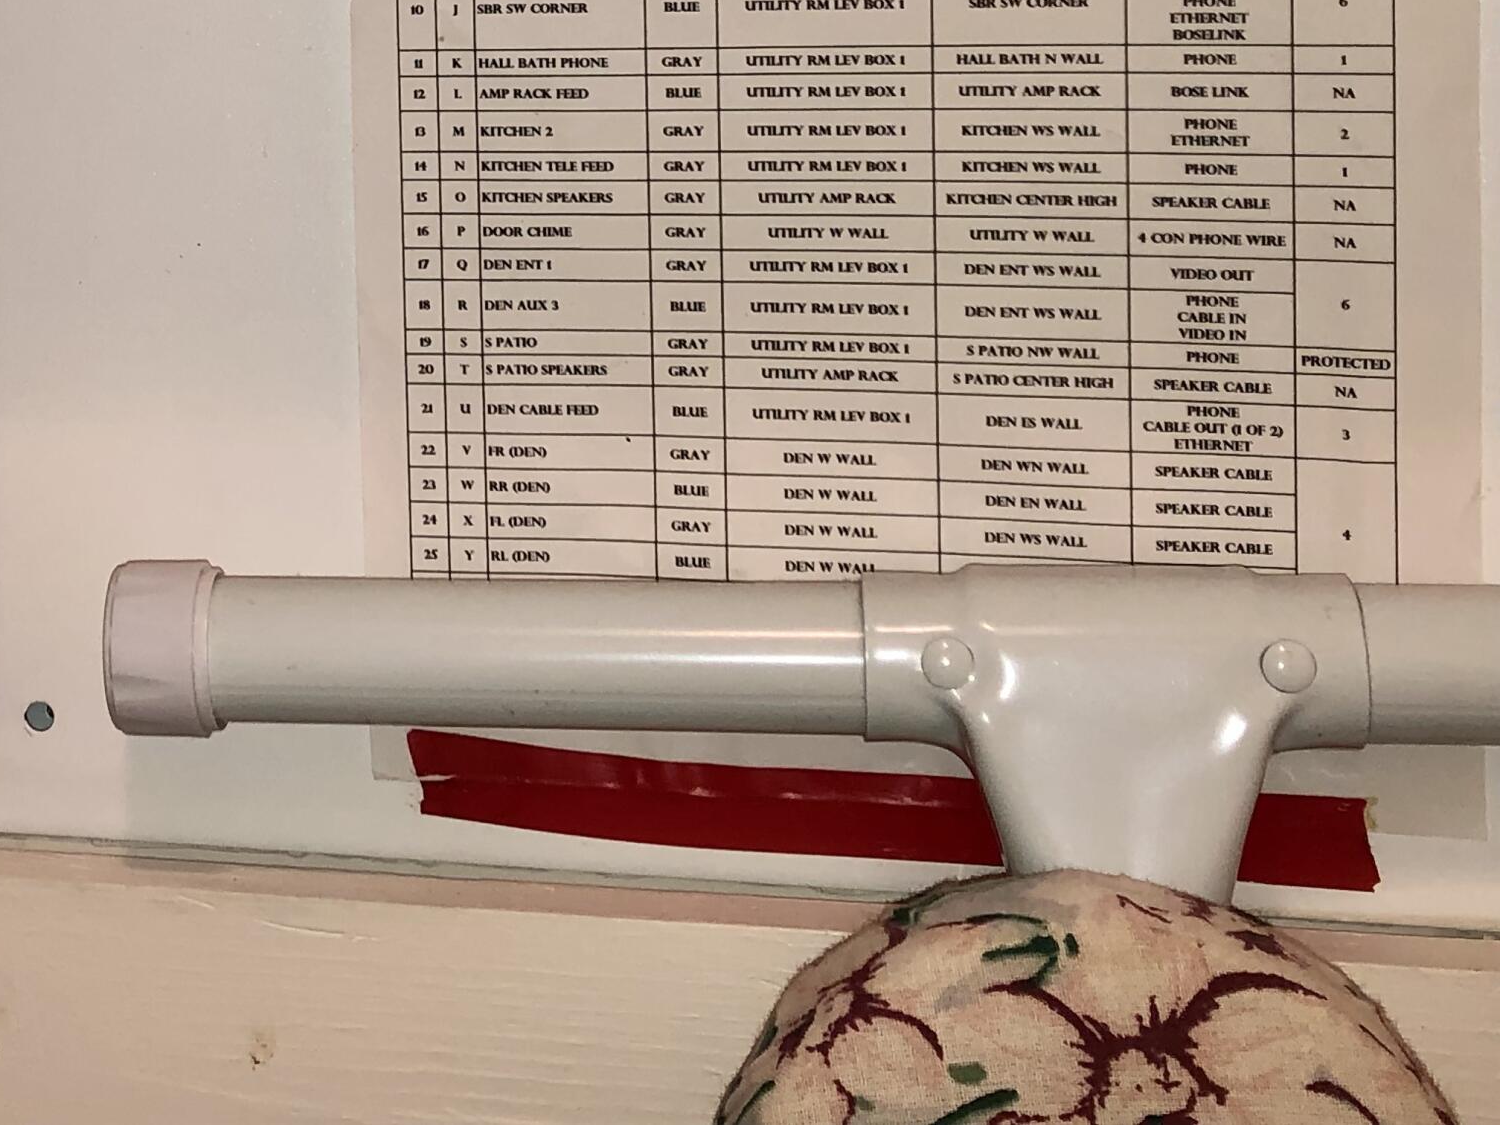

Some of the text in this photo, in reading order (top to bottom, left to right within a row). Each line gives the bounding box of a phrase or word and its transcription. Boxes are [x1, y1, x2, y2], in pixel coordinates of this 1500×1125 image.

[417, 226, 429, 236] 16
[457, 226, 465, 236] P
[482, 226, 572, 237] DOOR CHIME
[664, 226, 705, 237] GRAY
[768, 227, 888, 239] UTILITY W WALL
[969, 229, 1094, 242] UTILITY W WALL
[1138, 232, 1286, 246] 4 CON PHONE WIRE
[1334, 237, 1356, 248] NA
